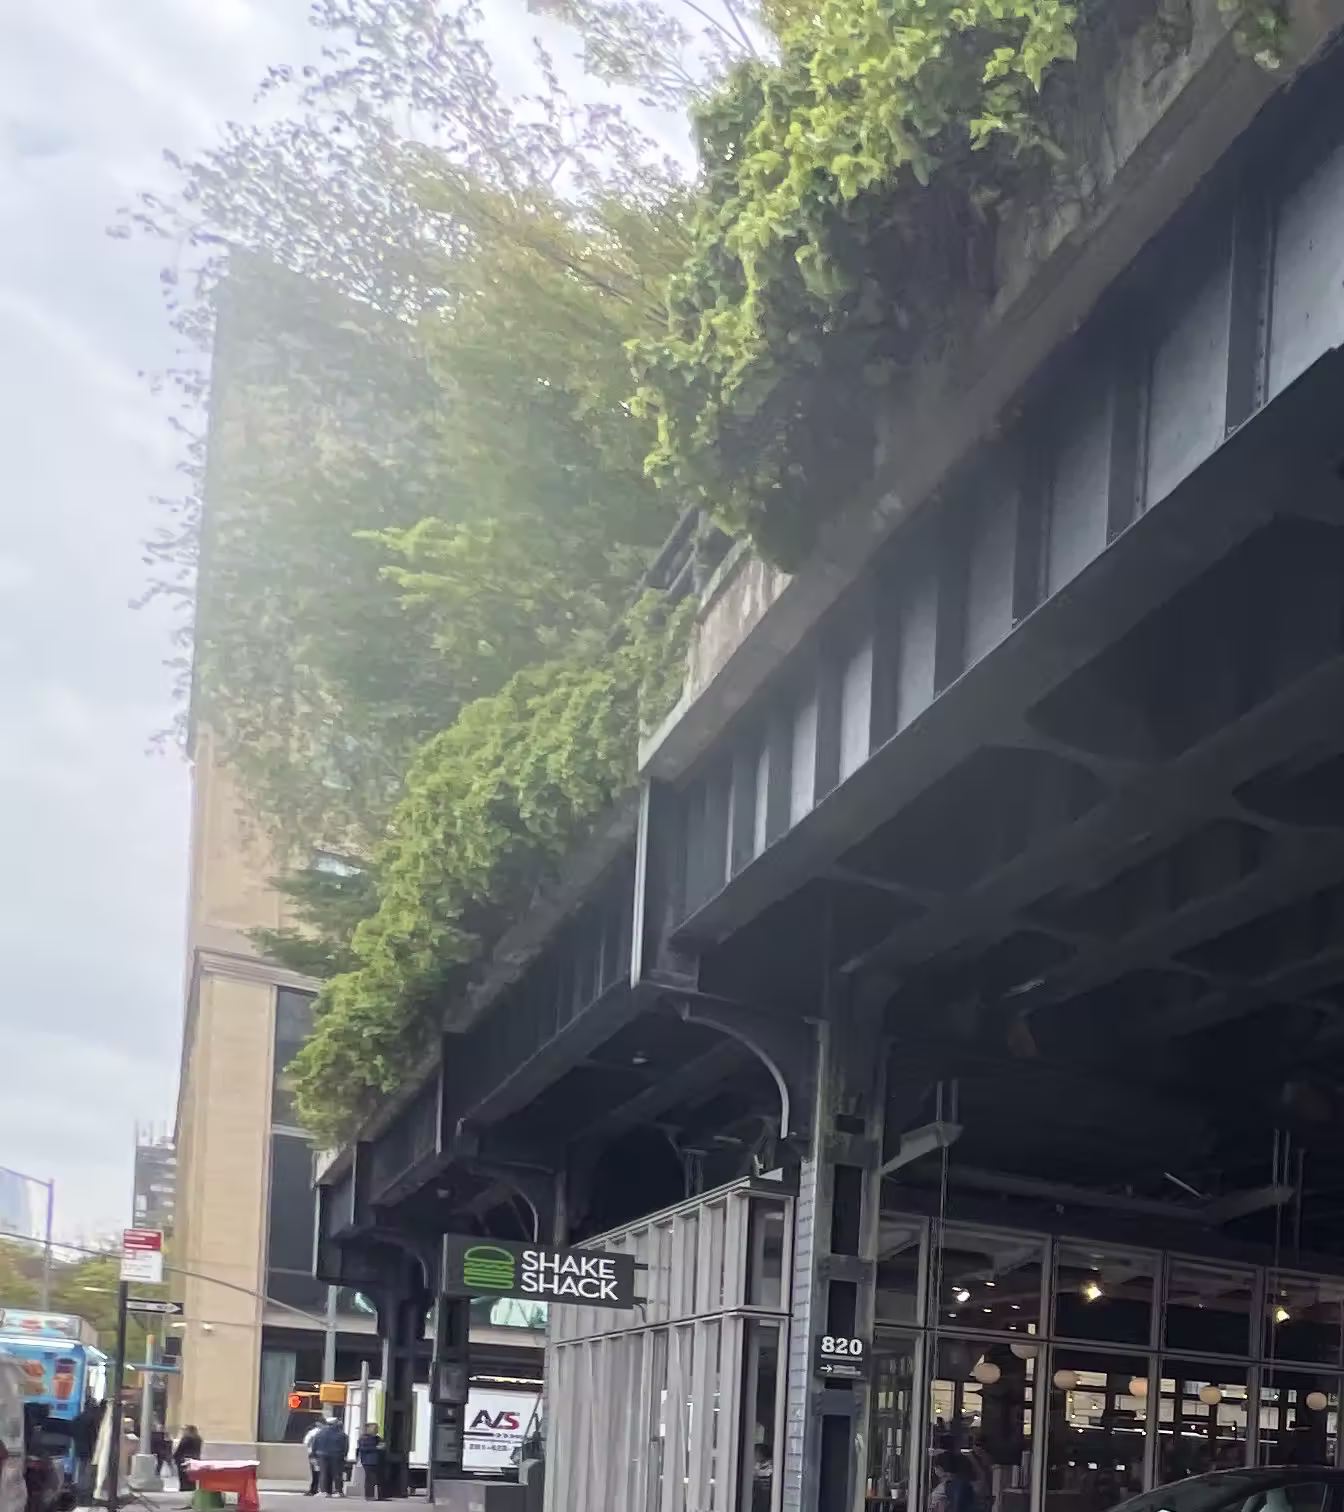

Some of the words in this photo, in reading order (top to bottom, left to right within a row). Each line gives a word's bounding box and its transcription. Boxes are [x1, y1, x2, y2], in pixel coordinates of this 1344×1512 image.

[521, 1250, 616, 1280] SHAKE
[520, 1272, 619, 1301] SHACK
[821, 1336, 863, 1355] 820
